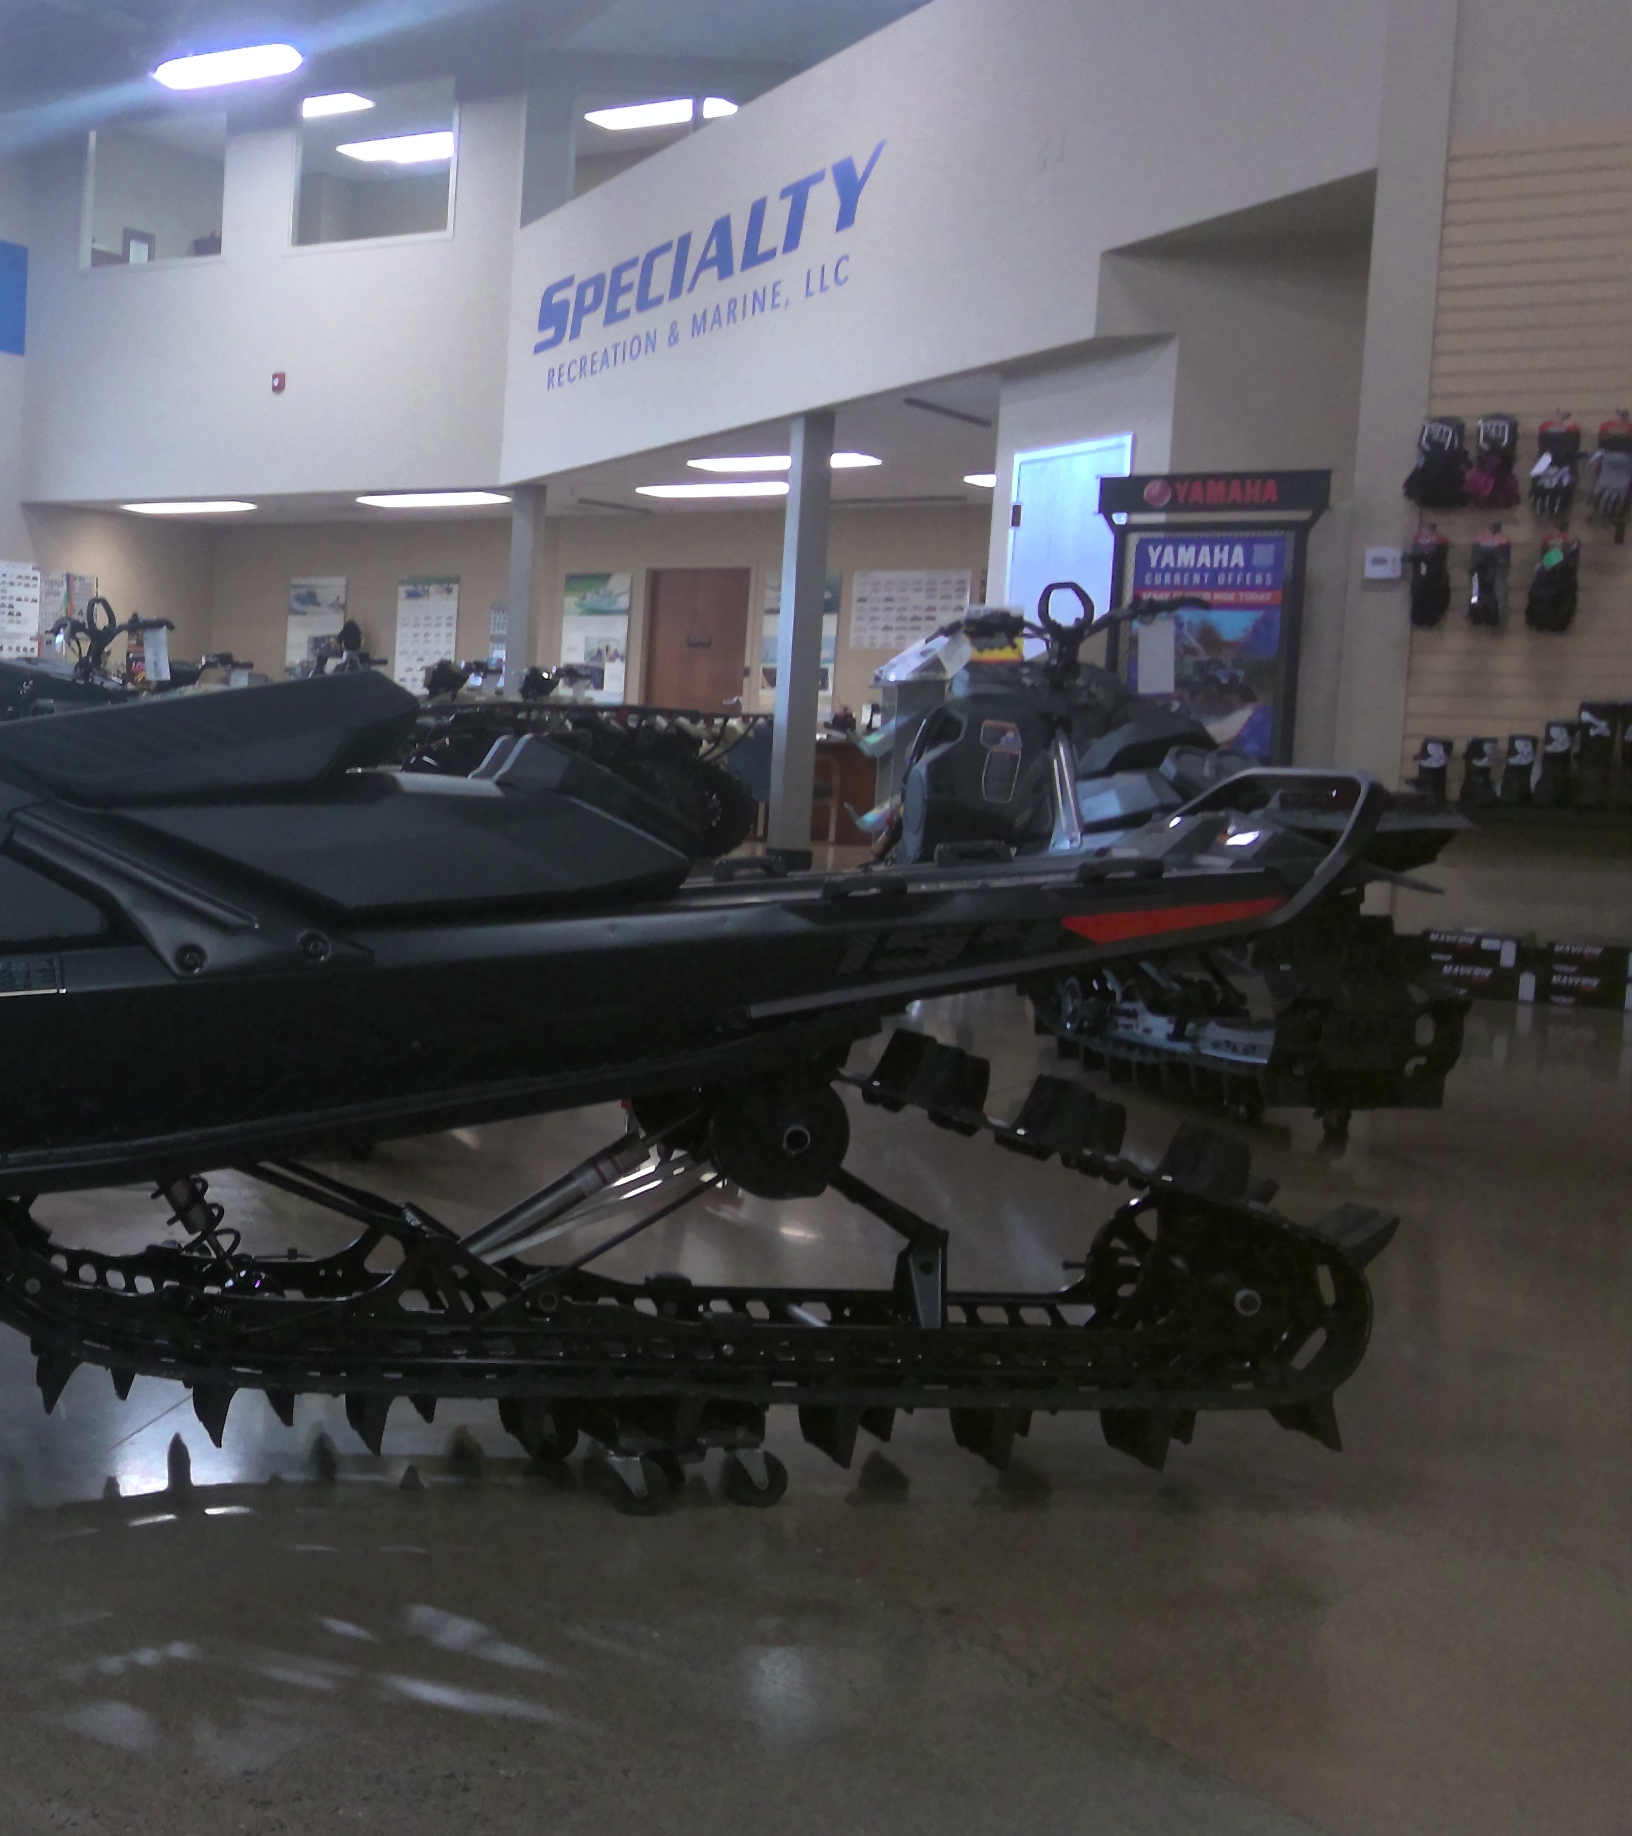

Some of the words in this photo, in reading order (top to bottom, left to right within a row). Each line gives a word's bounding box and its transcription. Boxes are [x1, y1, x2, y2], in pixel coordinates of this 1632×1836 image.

[533, 138, 887, 355] SPECIALTY
[546, 327, 658, 391] RECREATION
[668, 320, 680, 347] &
[690, 280, 790, 338] MARINE,
[804, 254, 850, 298] LLC
[1174, 478, 1278, 504] YAMAHA
[1148, 543, 1245, 568] YAMAHA
[1144, 571, 1209, 586] CURRENT
[1217, 571, 1273, 586] OFFERS
